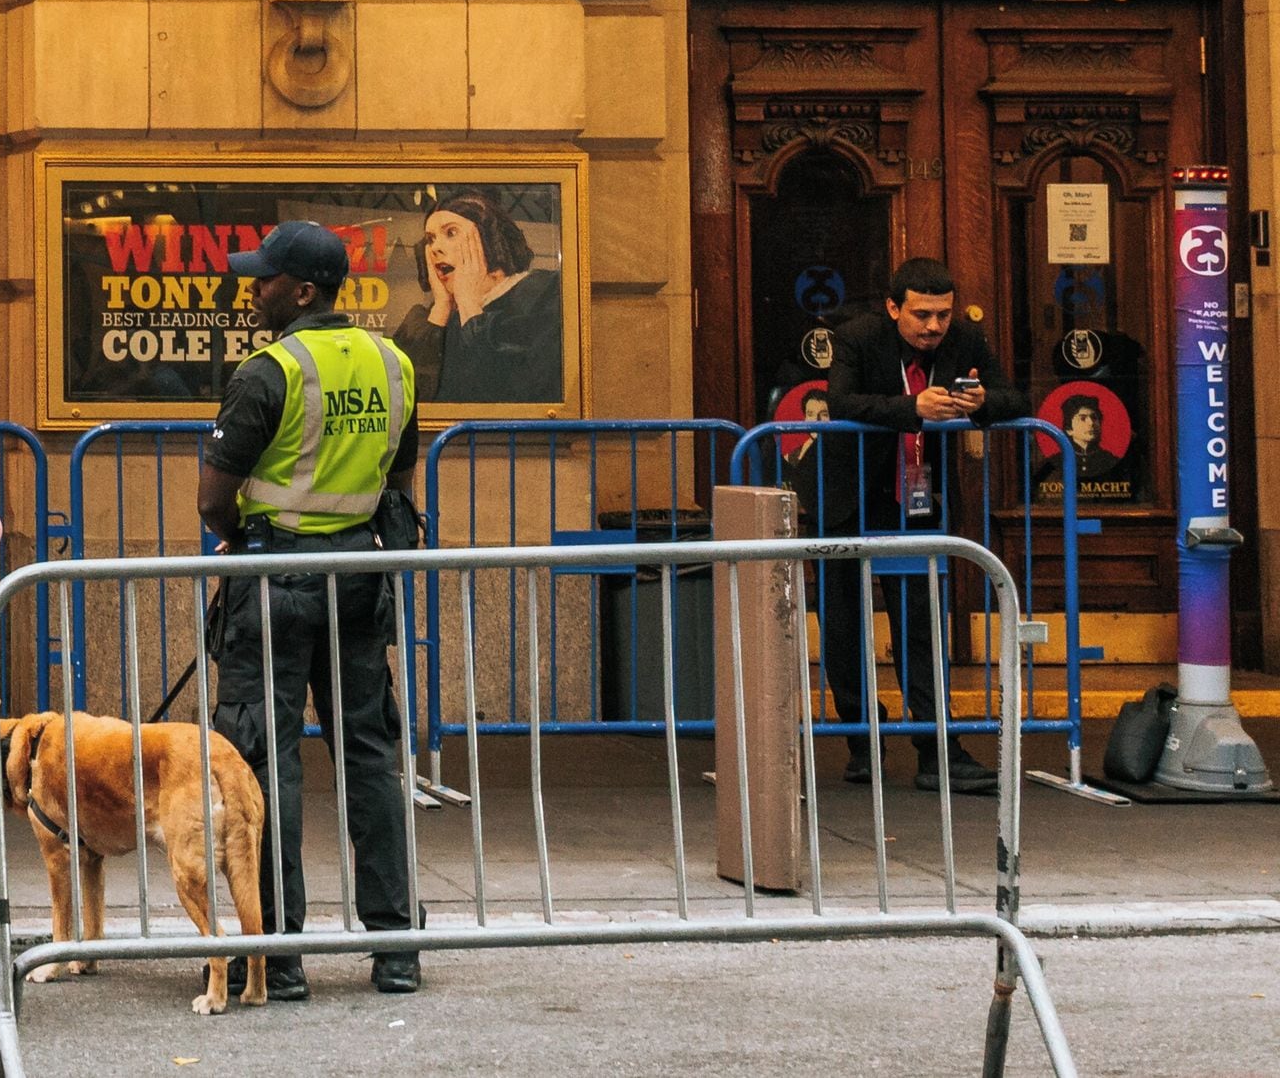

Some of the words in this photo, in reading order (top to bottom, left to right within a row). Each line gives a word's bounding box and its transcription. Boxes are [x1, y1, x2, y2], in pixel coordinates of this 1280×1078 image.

[907, 156, 943, 179] 149
[102, 276, 222, 309] TONY
[102, 313, 144, 327] BEST
[150, 313, 230, 328] LEADING
[102, 330, 211, 362] COLE
[325, 387, 387, 417] MSA
[348, 418, 387, 434] TEAM
[1198, 341, 1227, 508] WELCOME
[1081, 482, 1131, 493] MACHT
